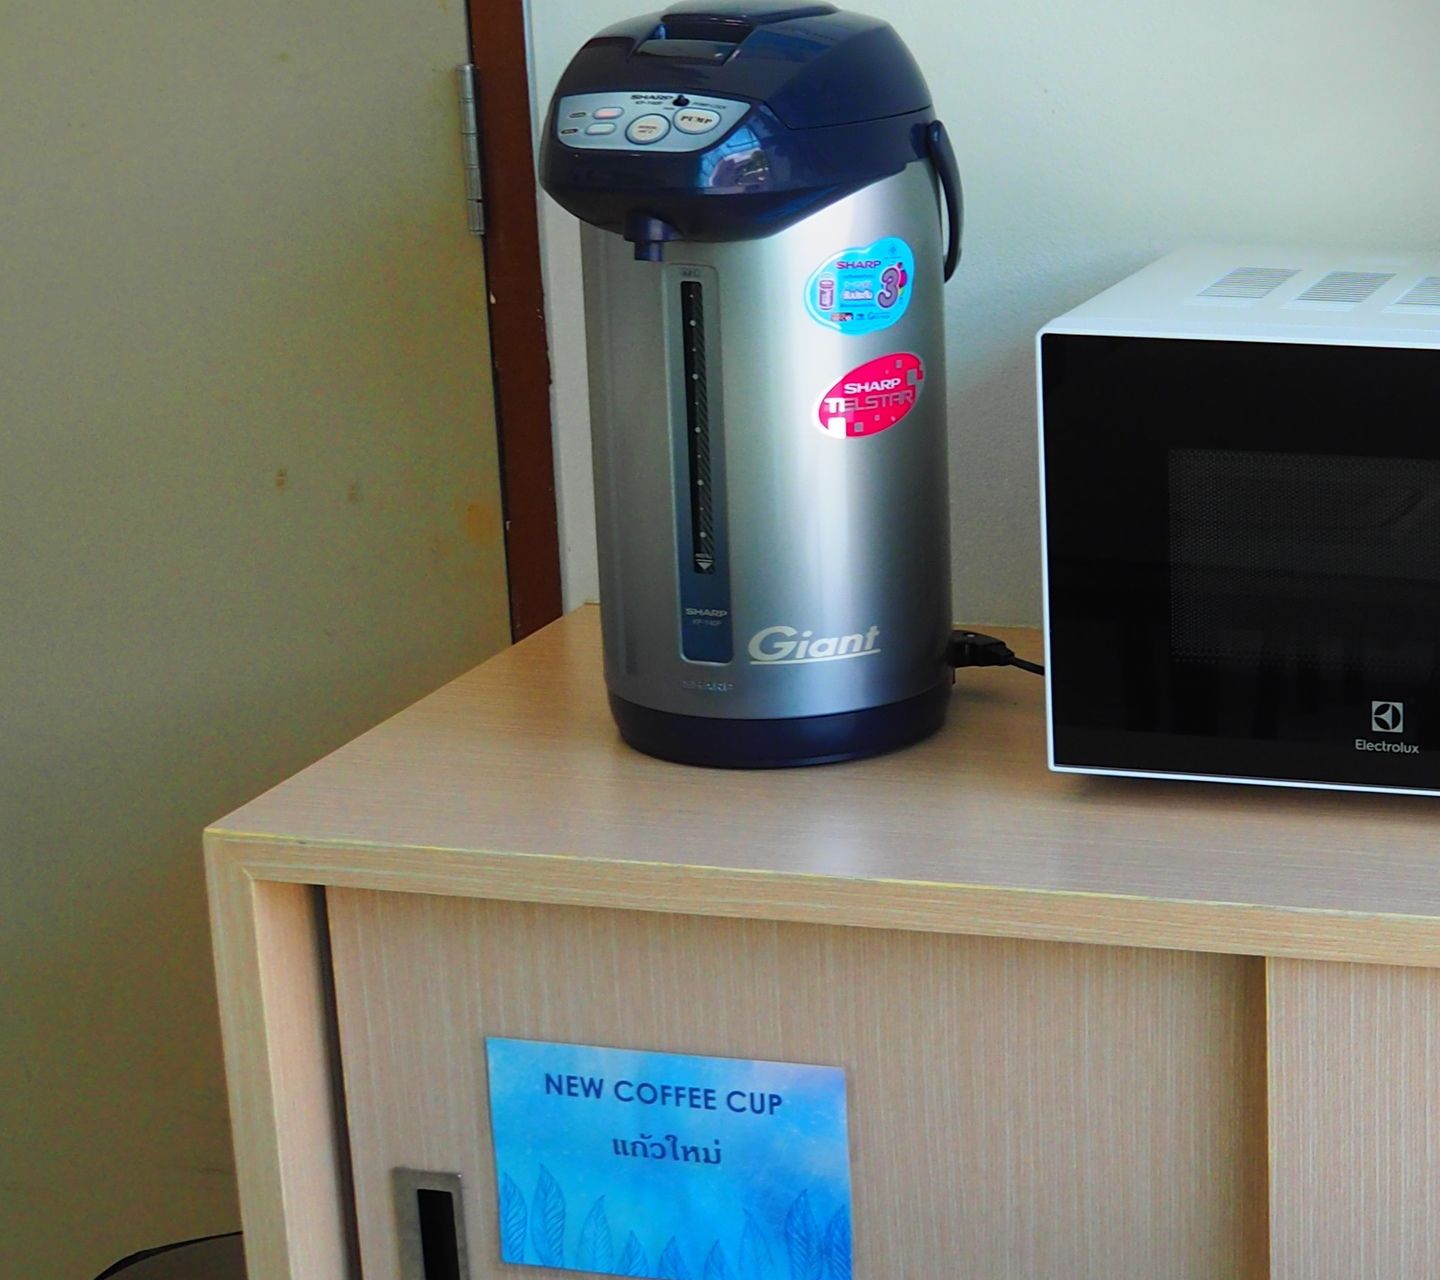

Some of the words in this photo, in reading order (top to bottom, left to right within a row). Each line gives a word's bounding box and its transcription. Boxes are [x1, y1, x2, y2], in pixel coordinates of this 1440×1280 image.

[680, 115, 713, 124] PUMP
[836, 260, 881, 270] SHARP
[844, 378, 901, 394] SHARP
[685, 607, 728, 618] SHARP
[748, 624, 881, 662] Giant
[1355, 738, 1420, 754] Electrolux
[544, 1073, 603, 1099] NEW
[614, 1080, 717, 1110] COFFEE
[726, 1090, 782, 1115] CUP
[612, 1134, 722, 1165] แก้วใหม่
